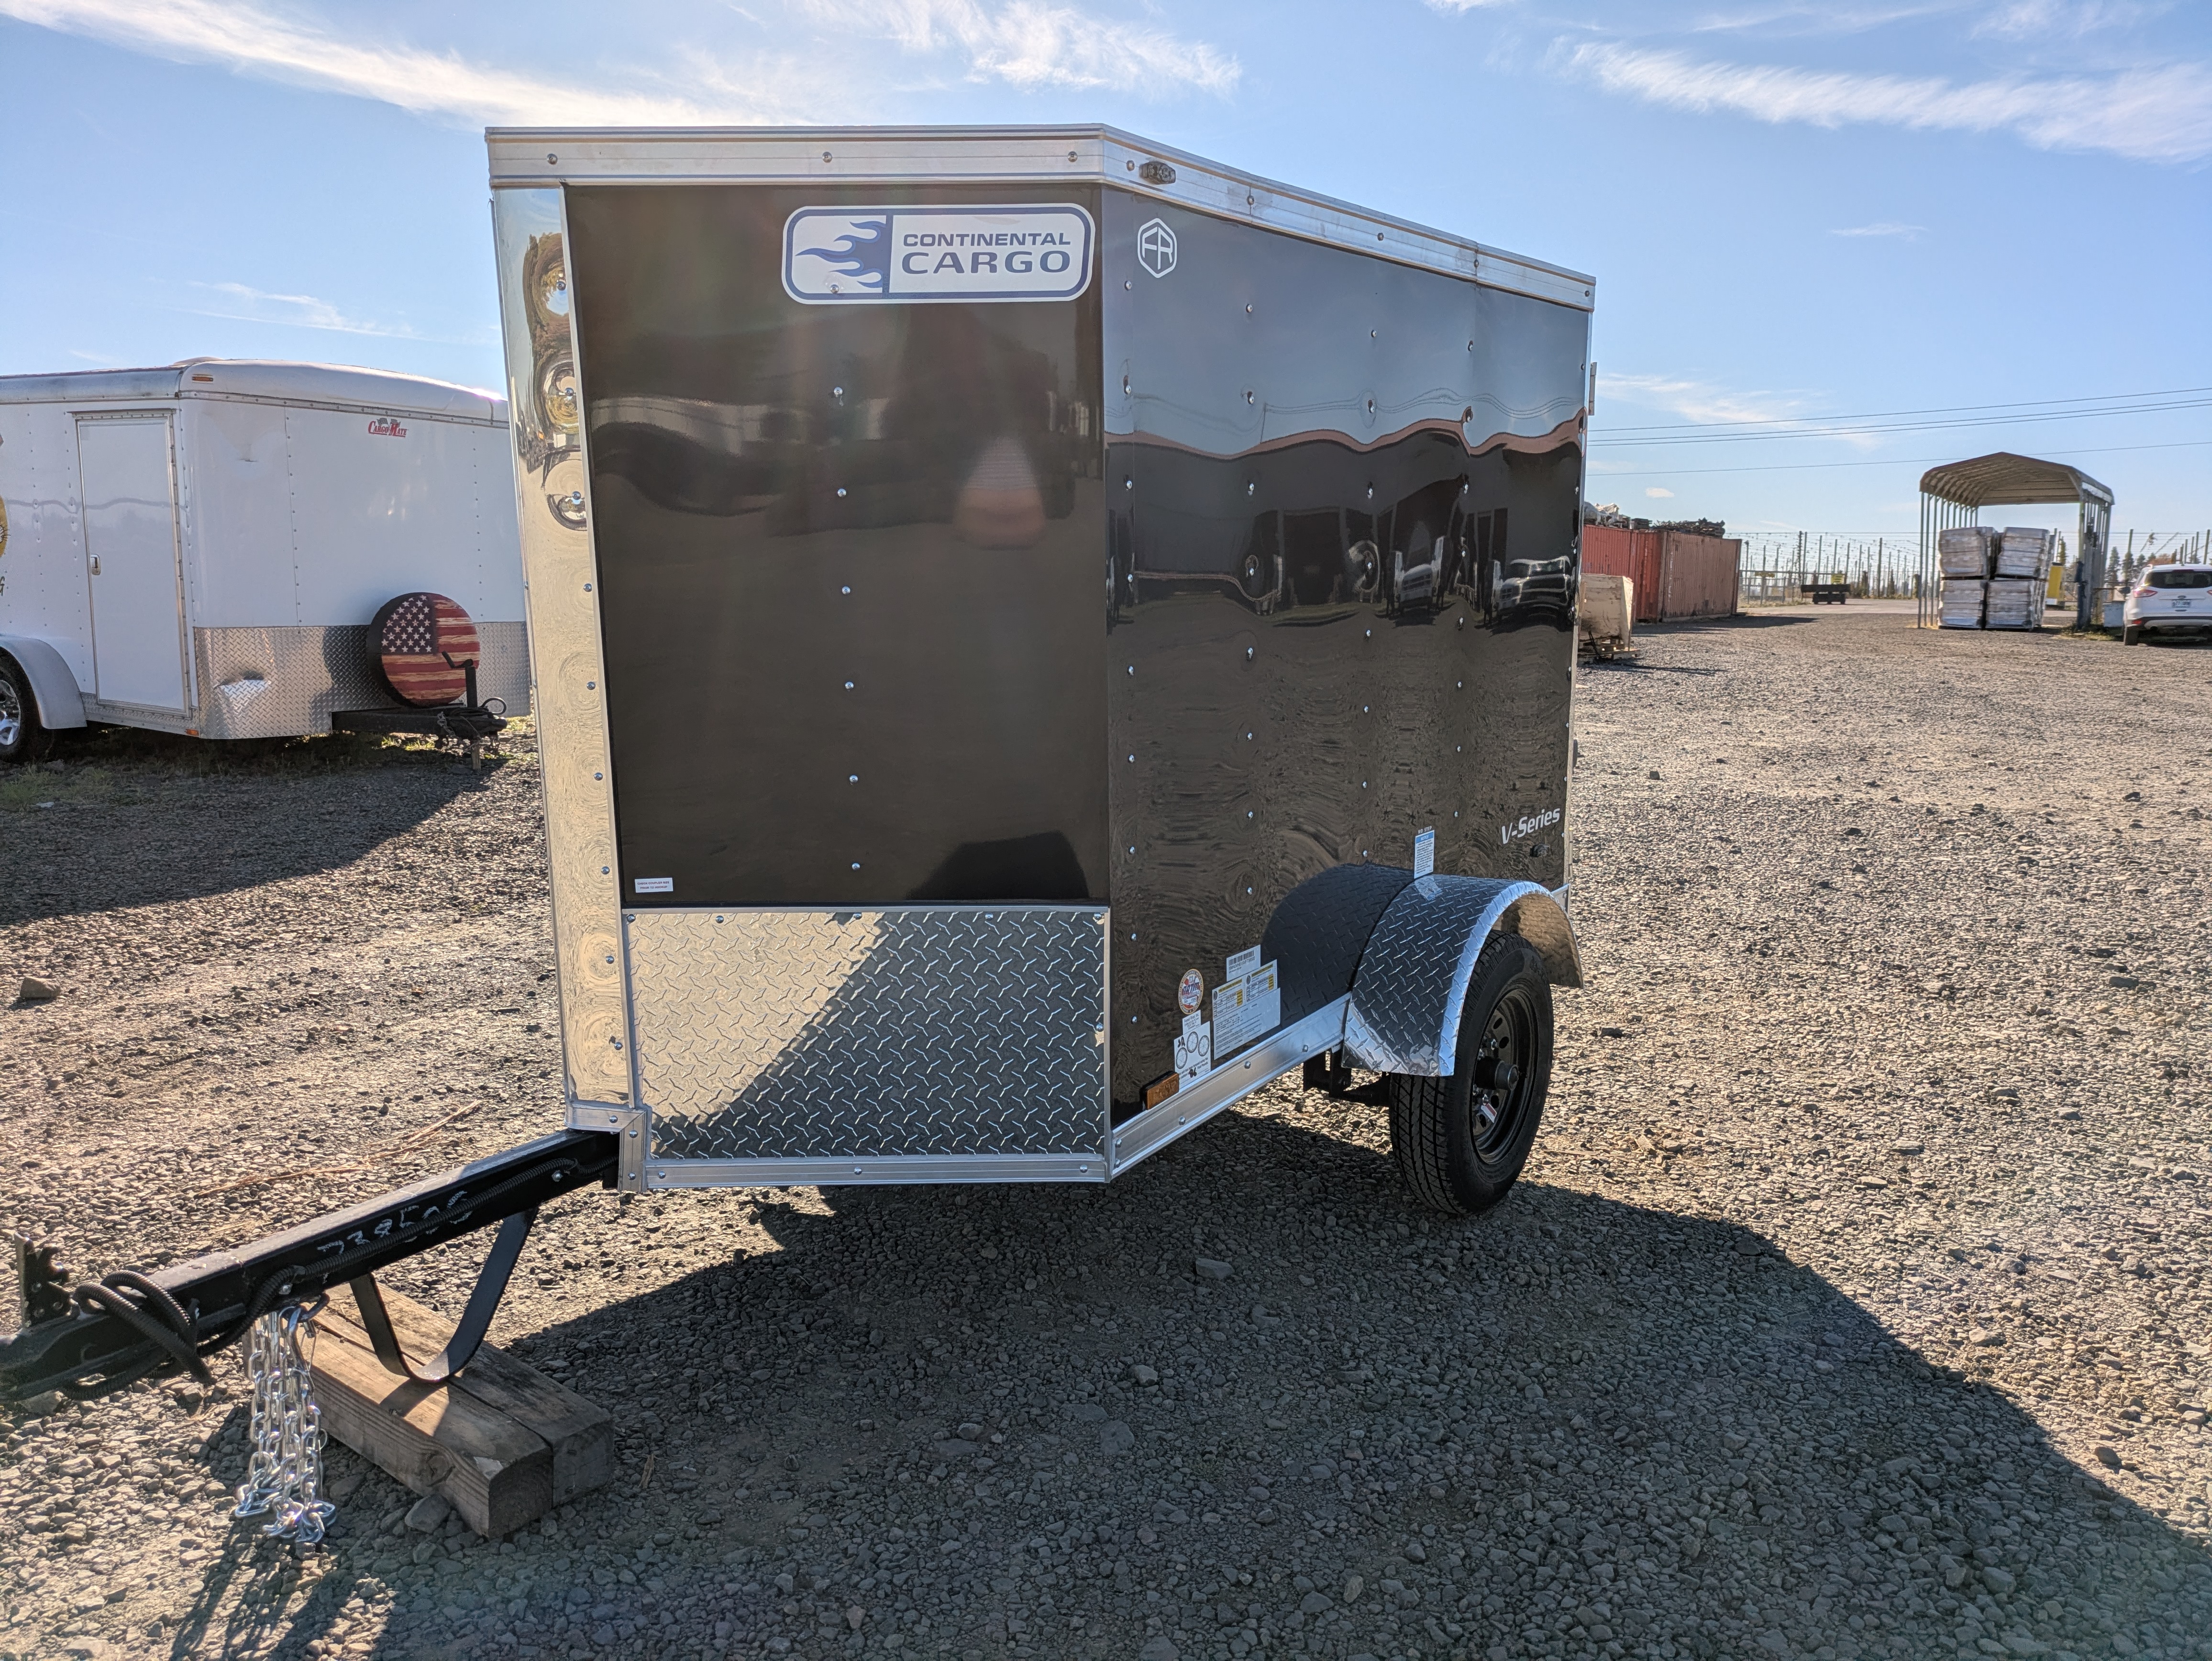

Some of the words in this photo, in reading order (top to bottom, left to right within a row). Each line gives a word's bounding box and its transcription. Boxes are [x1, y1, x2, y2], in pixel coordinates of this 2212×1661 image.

[903, 232, 1072, 248] CONTINENTAL
[901, 251, 1071, 275] CARGO
[1502, 808, 1560, 844] V-Series
